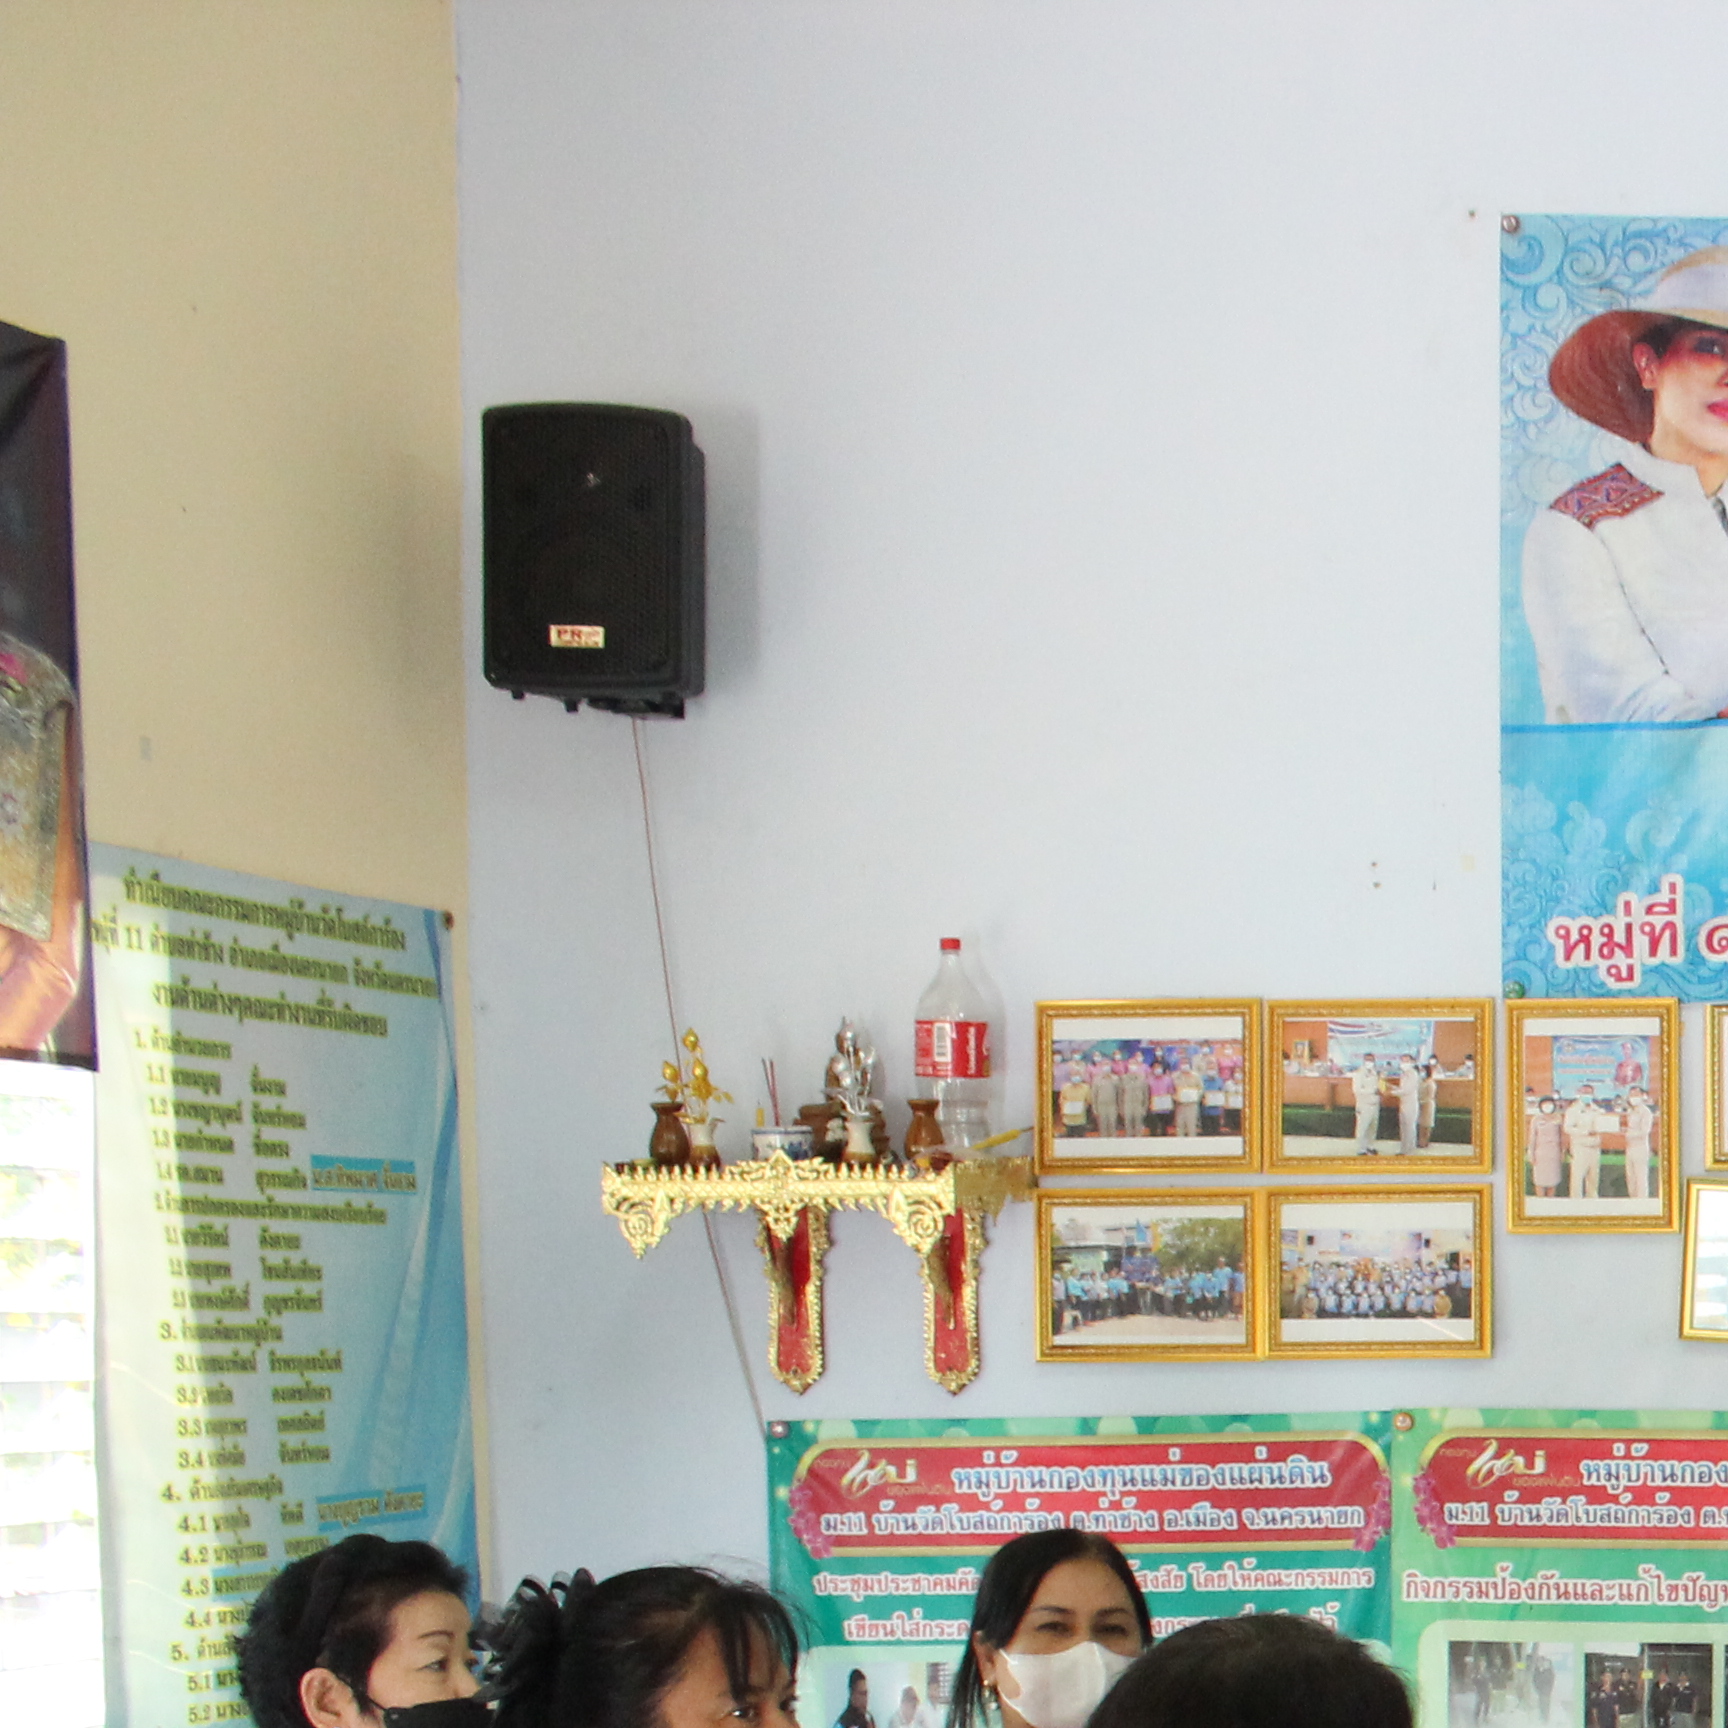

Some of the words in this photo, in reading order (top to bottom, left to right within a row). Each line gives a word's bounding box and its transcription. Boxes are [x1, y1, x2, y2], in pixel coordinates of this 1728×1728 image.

[1550, 885, 1682, 984] หมู่ที่
[952, 1447, 1331, 1502] หมู่บ้านกองทุนแม่ของแผ่นดิน
[821, 1513, 867, 1537] ม.11
[1164, 1503, 1236, 1530] อ.เมือง
[1446, 1504, 1488, 1527] ม.11
[1497, 1492, 1694, 1527] บ้านวัดโบสถ์การ้อง
[188, 1704, 214, 1723] 5.2
